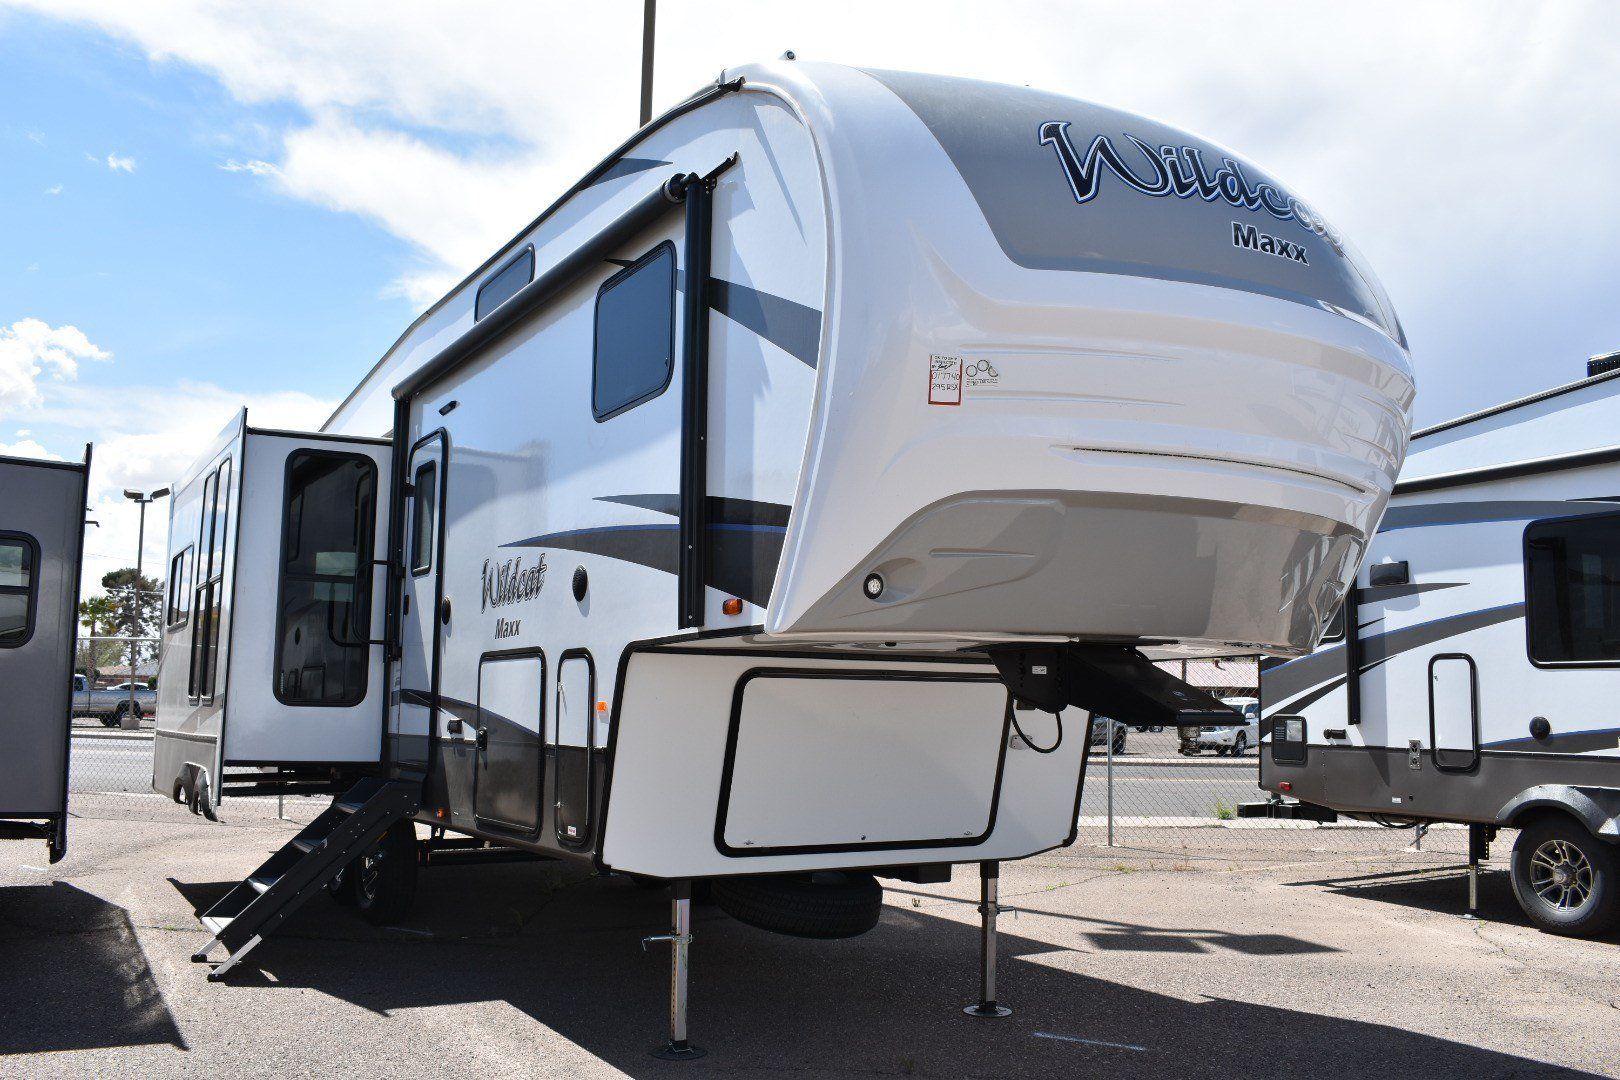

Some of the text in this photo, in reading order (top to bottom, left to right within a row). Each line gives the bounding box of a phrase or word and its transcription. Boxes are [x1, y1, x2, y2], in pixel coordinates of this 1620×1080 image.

[1231, 221, 1309, 266] Maxx
[481, 552, 548, 615] Wildcat
[494, 617, 522, 640] Maxx
